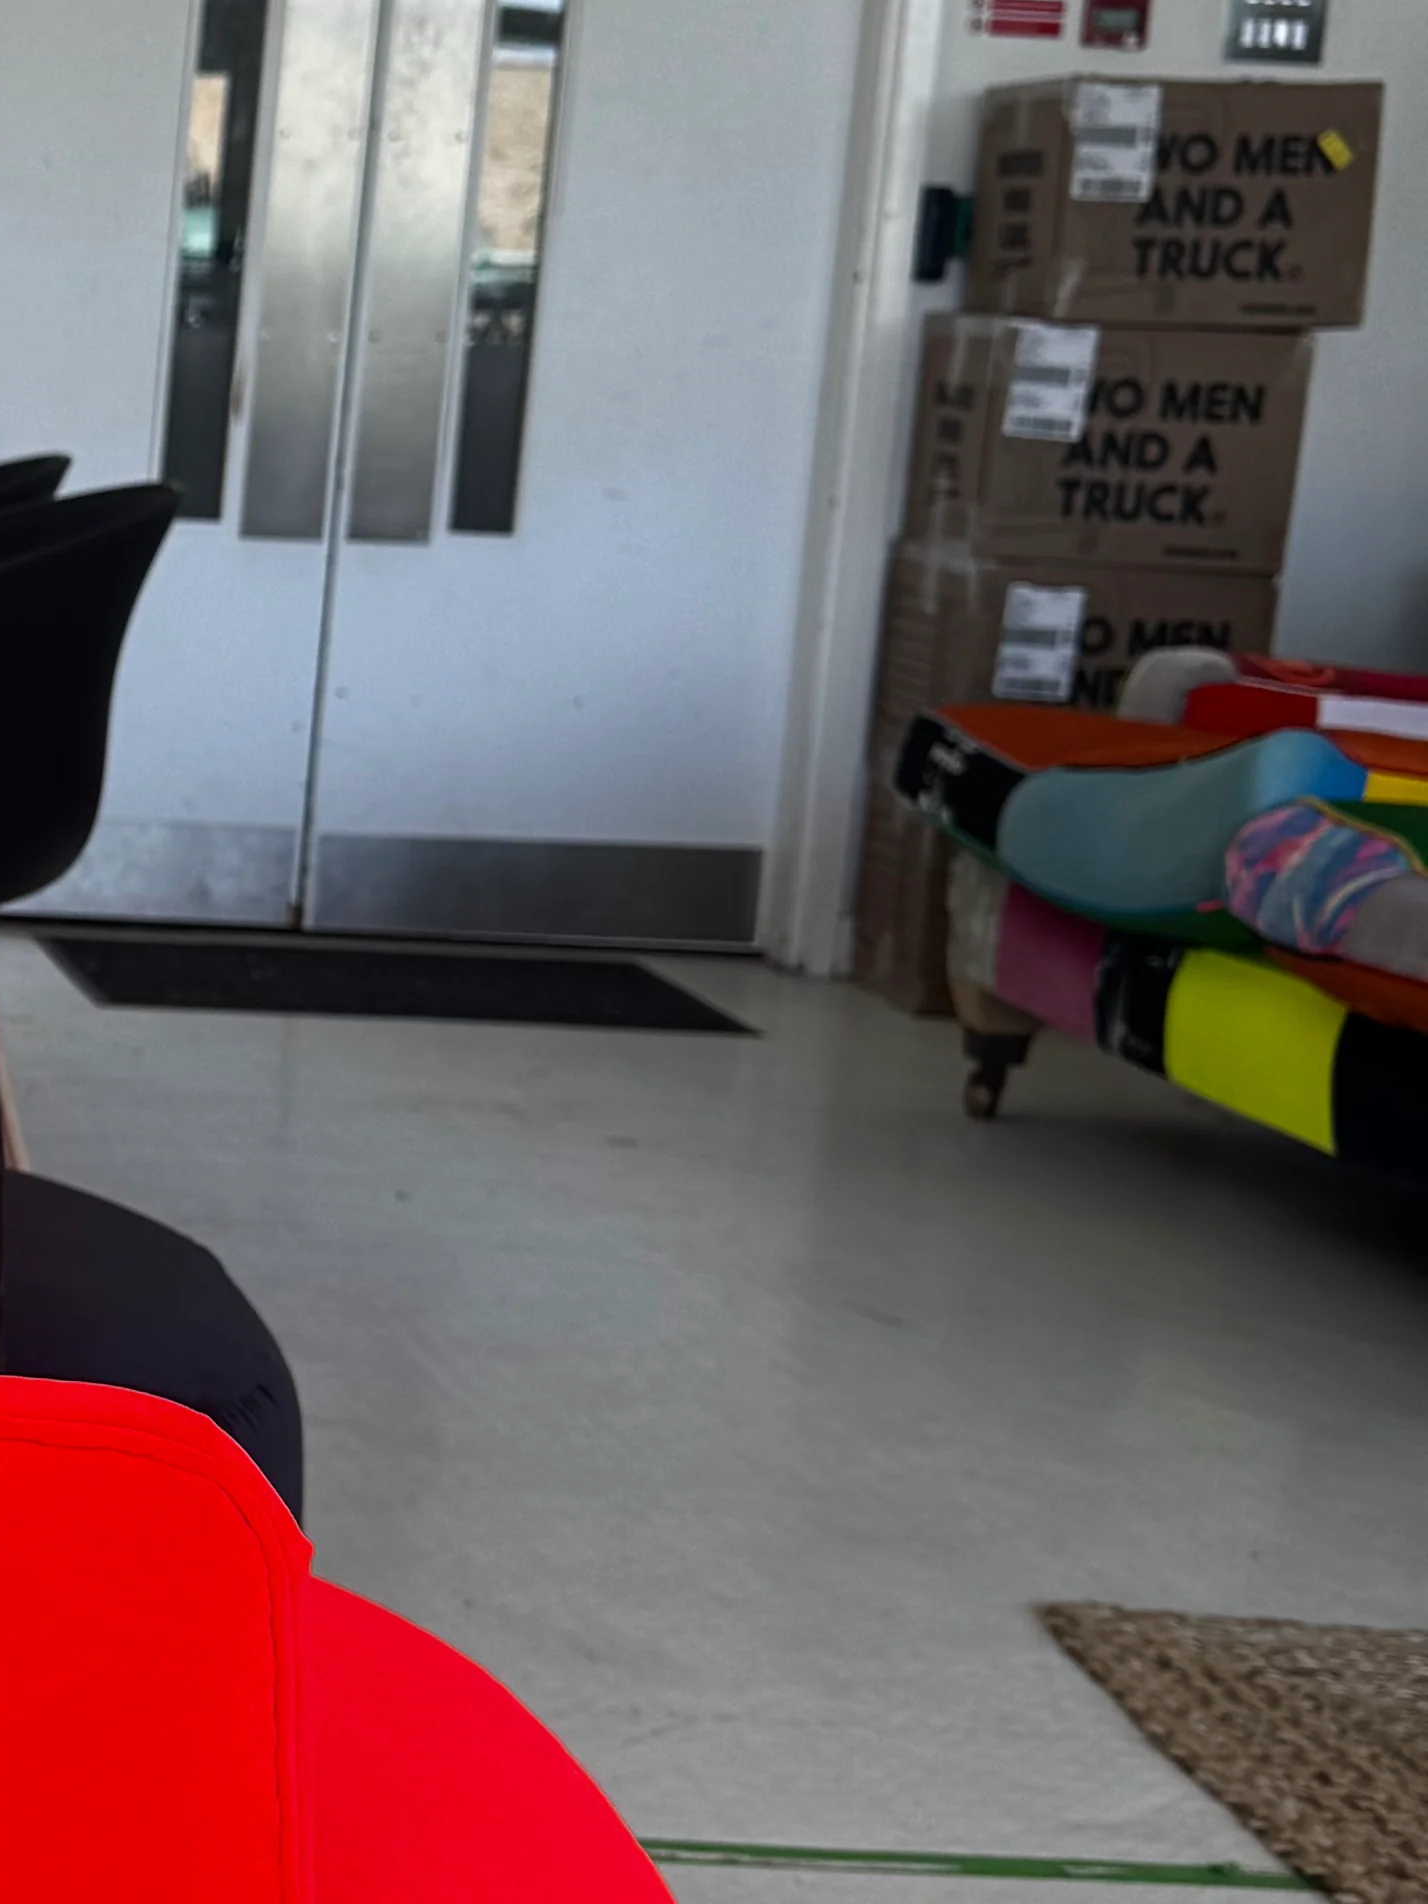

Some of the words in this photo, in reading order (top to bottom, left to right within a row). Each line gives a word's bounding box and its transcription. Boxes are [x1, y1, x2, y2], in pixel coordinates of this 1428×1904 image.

[1232, 133, 1336, 177] MEN
[1136, 186, 1243, 229] AND
[1258, 186, 1293, 230] A
[1159, 381, 1265, 426] MEN
[1062, 431, 1169, 470] AND
[1181, 433, 1219, 475] A
[1129, 619, 1231, 657] MEN
